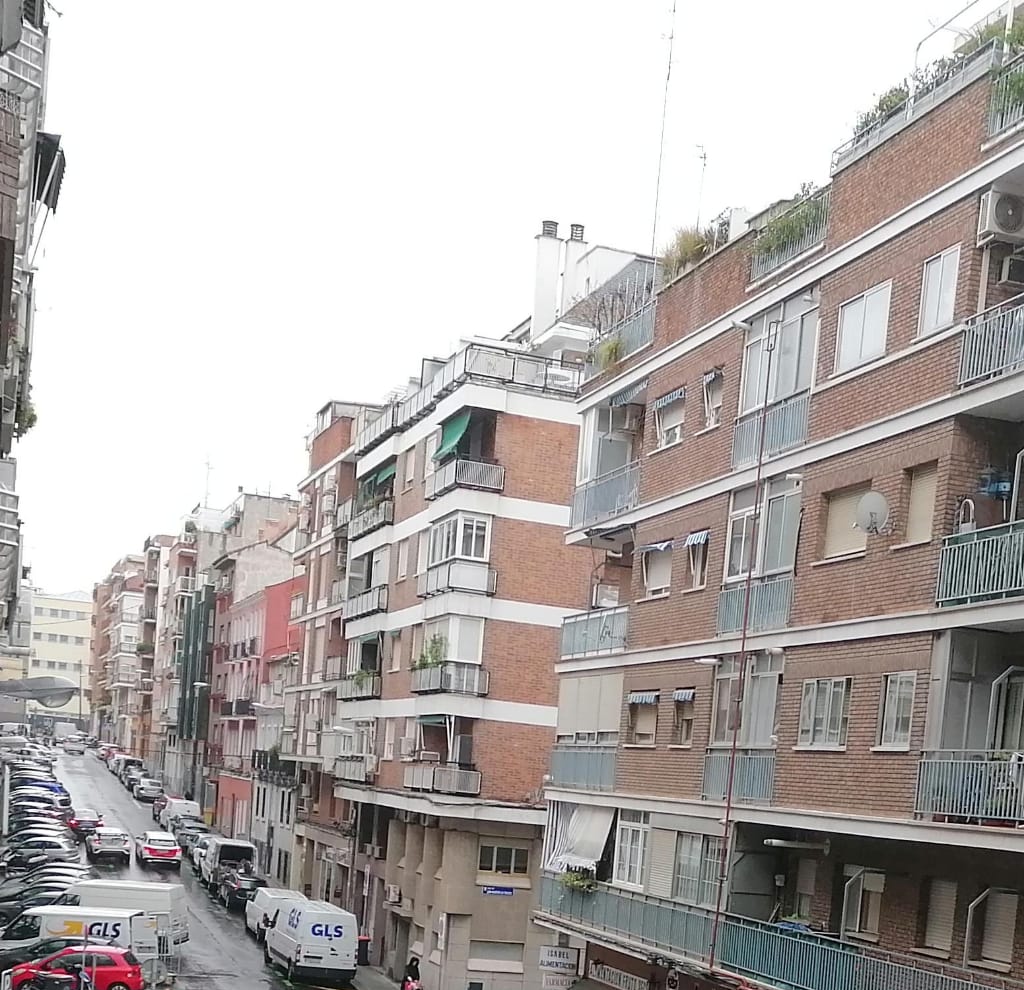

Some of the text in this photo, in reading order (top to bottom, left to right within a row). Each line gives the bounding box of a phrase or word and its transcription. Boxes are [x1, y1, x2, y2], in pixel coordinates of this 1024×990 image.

[89, 921, 121, 939] GLS
[311, 923, 344, 939] GLS
[547, 949, 570, 959] ISABEL
